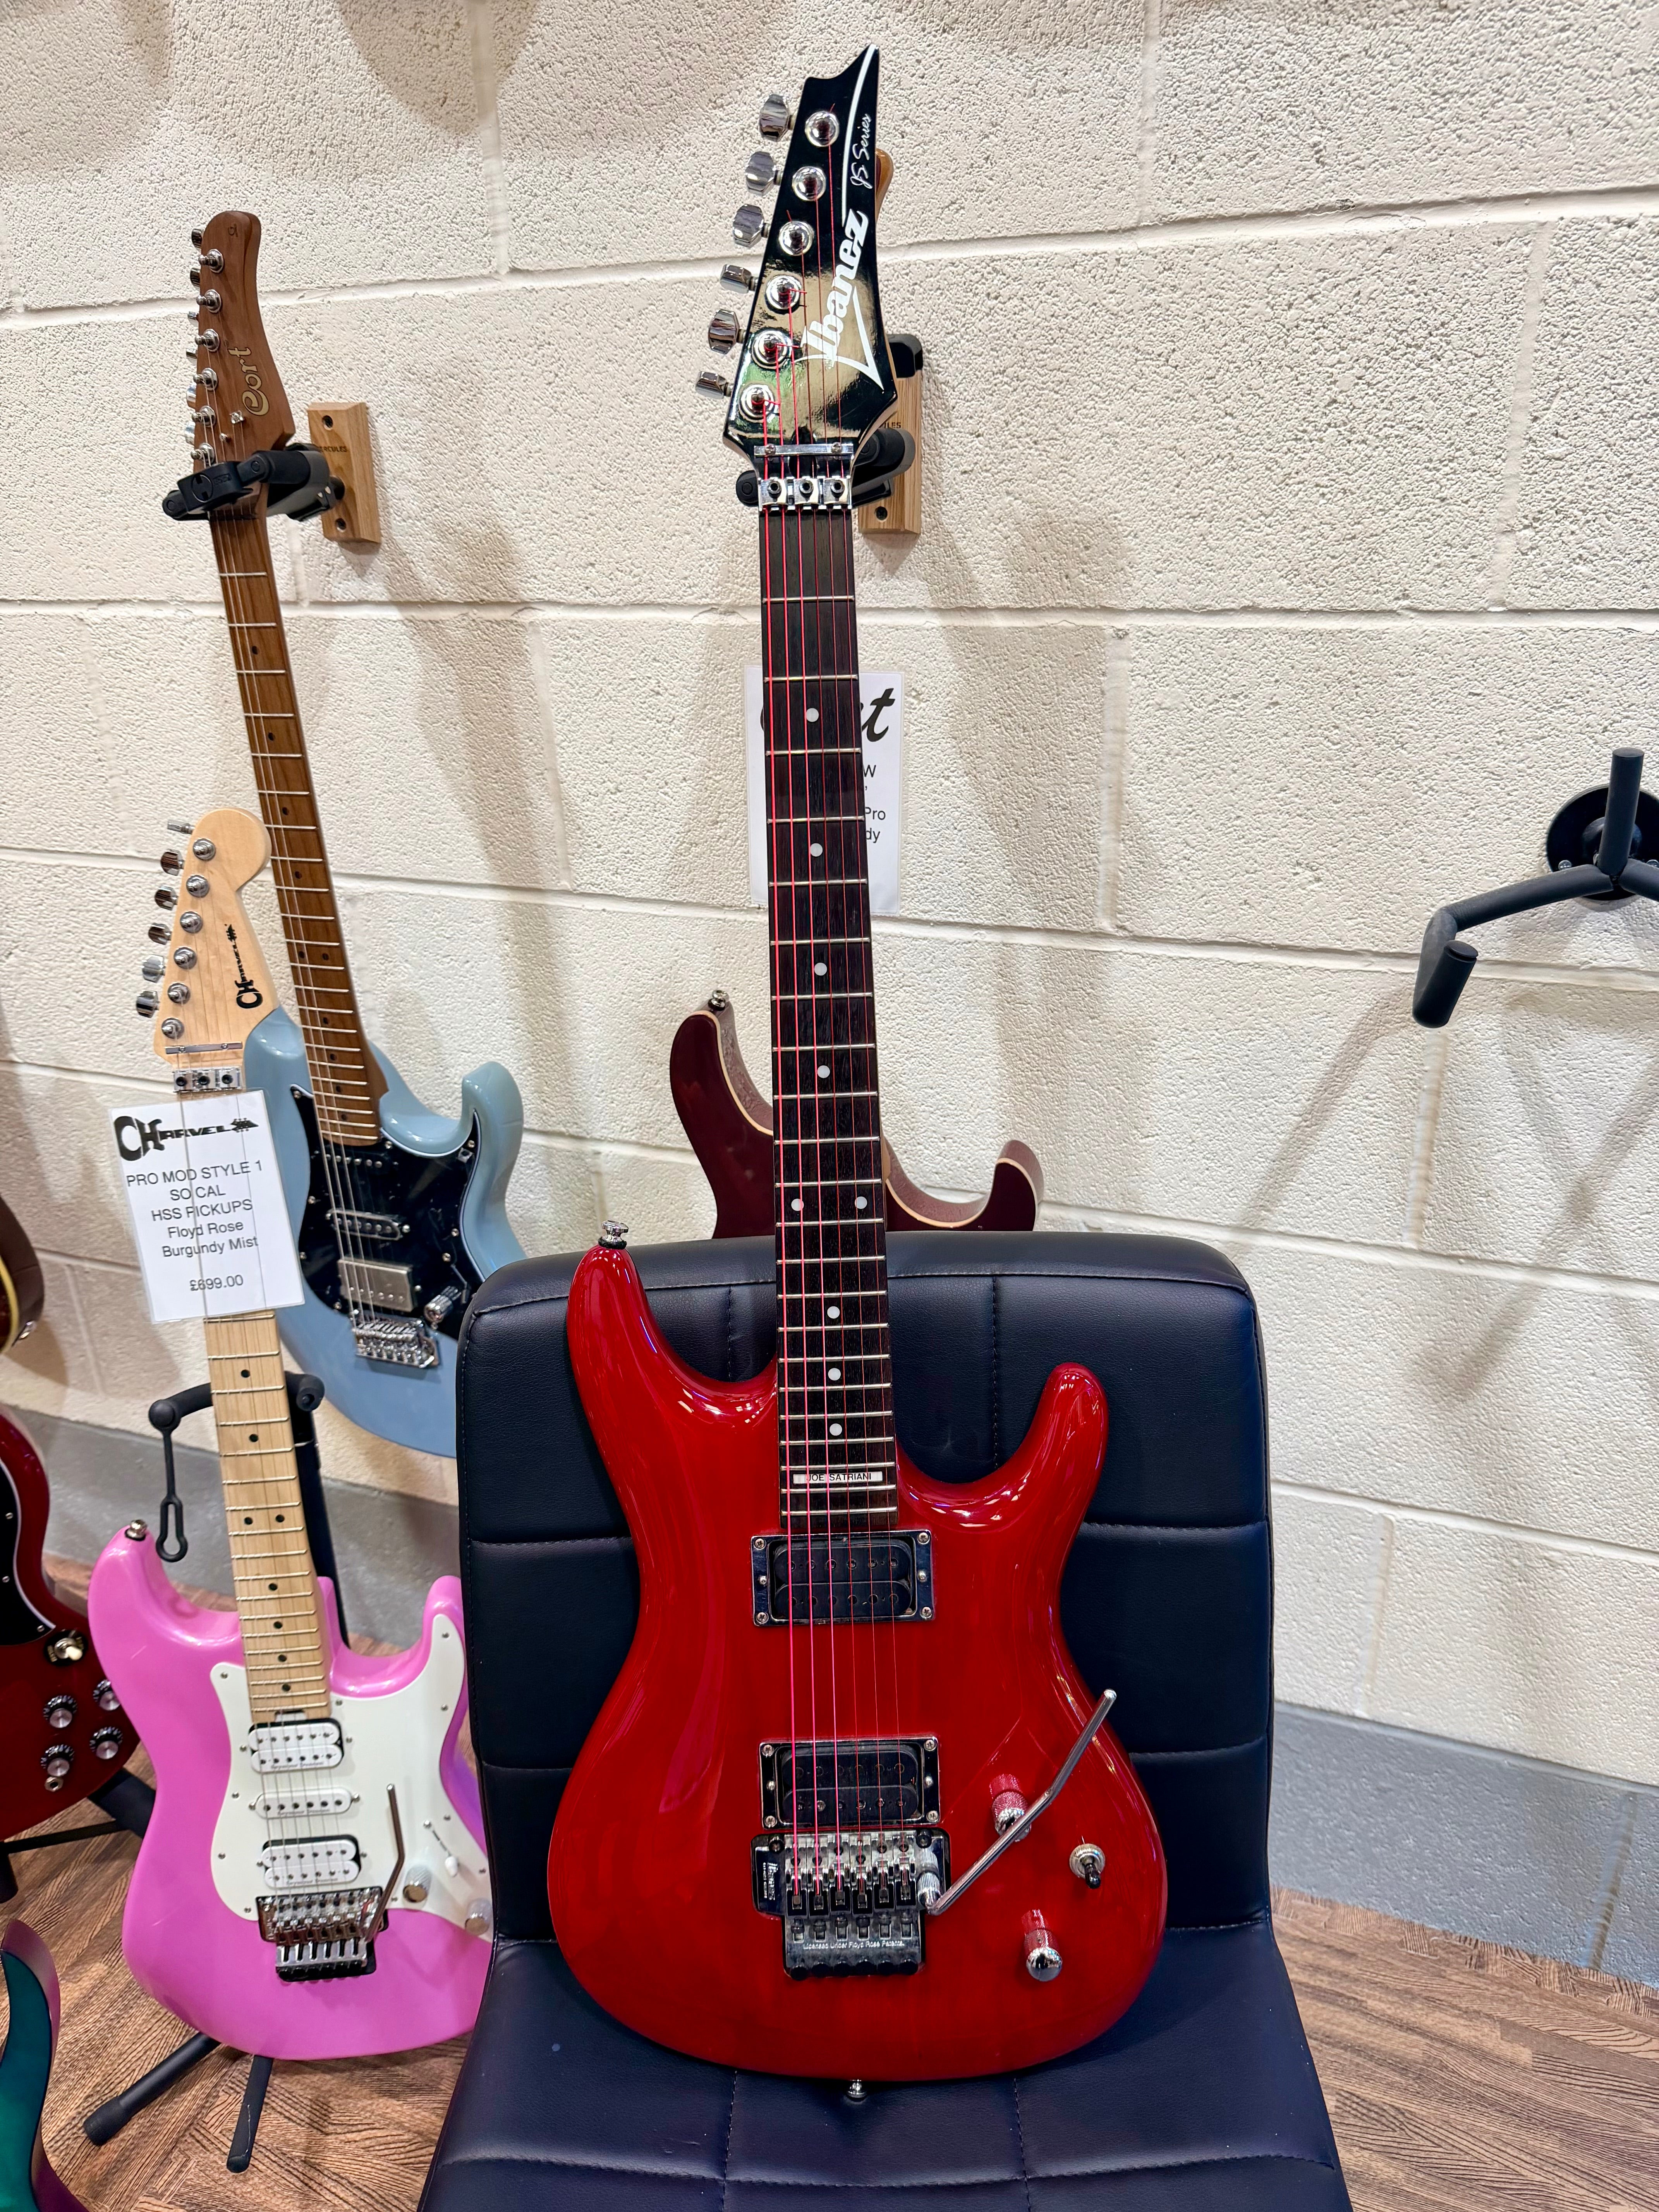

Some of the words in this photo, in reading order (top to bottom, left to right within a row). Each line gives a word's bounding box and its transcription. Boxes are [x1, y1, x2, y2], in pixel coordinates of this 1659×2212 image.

[852, 113, 871, 160] Series
[800, 208, 869, 372] Ibanez
[227, 347, 270, 416] Cort
[126, 1172, 158, 1187] PRO
[163, 1169, 197, 1183] MOD
[201, 1161, 250, 1180] STYLE
[256, 1160, 262, 1171] 1
[170, 1188, 191, 1201] SO
[195, 1185, 226, 1198] CAL
[151, 1207, 182, 1221] HSS
[186, 1199, 253, 1218] PICKUPS
[167, 1224, 203, 1239] Floyd
[208, 1221, 244, 1234] Rose
[162, 1241, 225, 1258] Burgundy
[230, 1235, 259, 1250] Mist
[189, 1274, 244, 1291] £699.00
[829, 1472, 871, 1481] SATRIANI
